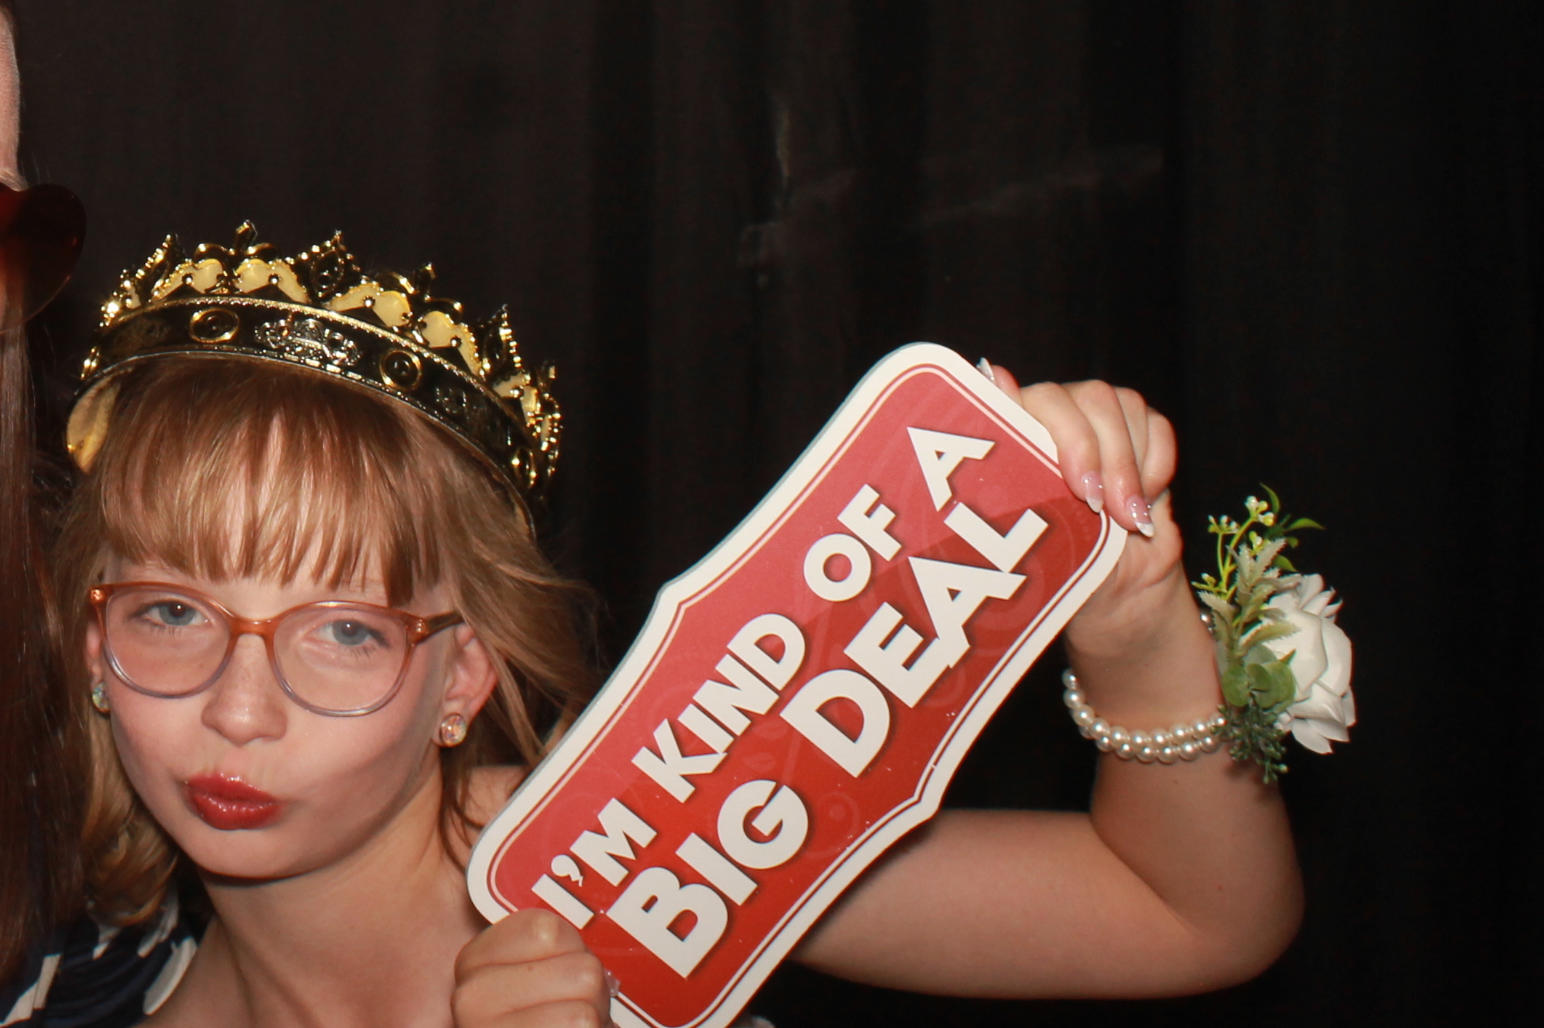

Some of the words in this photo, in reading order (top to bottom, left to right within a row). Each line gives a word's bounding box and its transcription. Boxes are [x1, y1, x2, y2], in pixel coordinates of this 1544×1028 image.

[532, 798, 657, 929] I'M
[631, 613, 805, 803] KIND
[803, 484, 902, 602] OF
[907, 426, 996, 511] A
[606, 779, 809, 978] BIG
[779, 501, 1049, 778] DEAL
